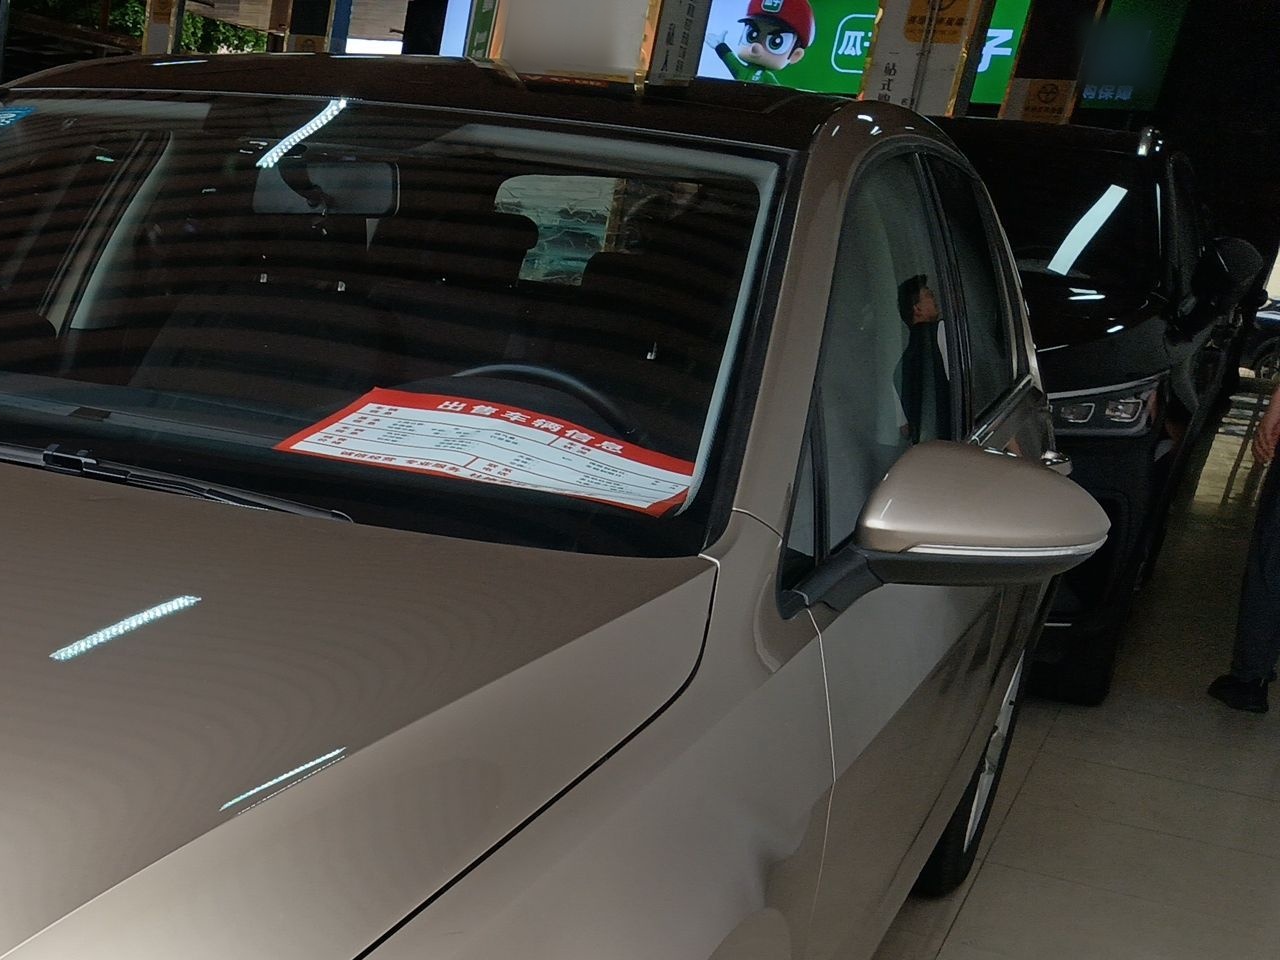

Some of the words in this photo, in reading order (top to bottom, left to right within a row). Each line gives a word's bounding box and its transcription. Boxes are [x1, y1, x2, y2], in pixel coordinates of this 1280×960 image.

[837, 30, 871, 56] 瓜
[436, 400, 624, 454] 出售车辆信息
